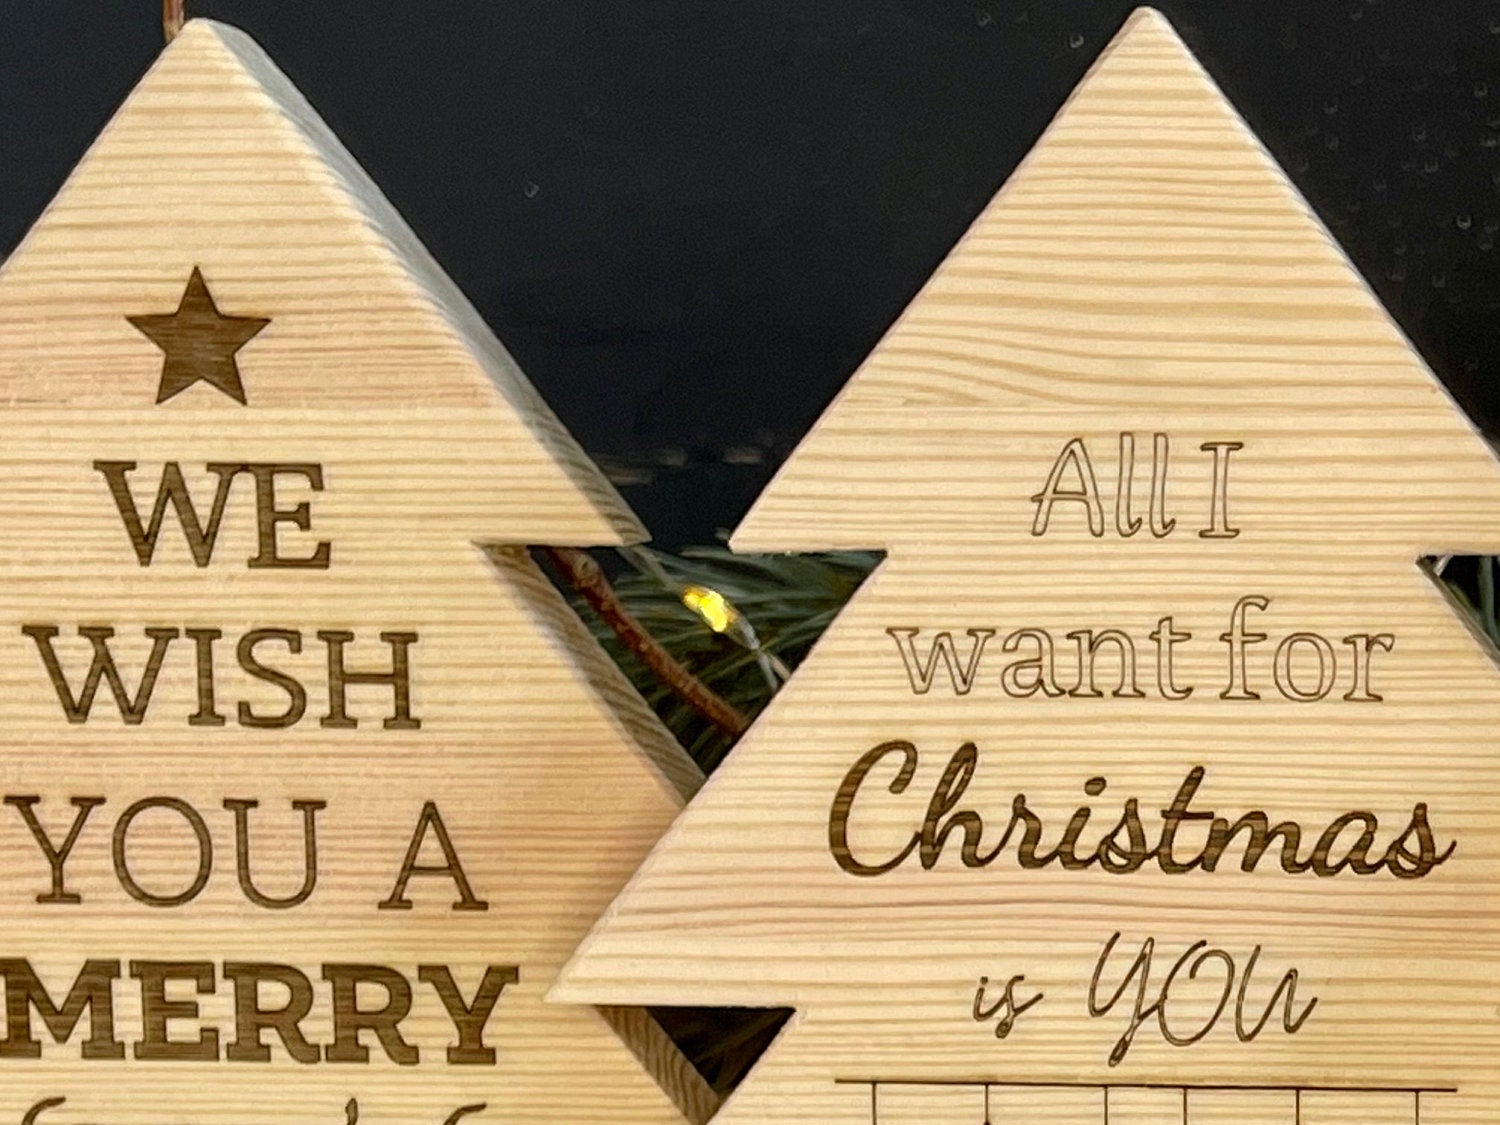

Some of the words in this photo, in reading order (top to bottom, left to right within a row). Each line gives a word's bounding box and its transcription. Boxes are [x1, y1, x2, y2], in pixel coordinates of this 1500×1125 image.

[91, 459, 332, 571] WE
[1029, 430, 1177, 539] All
[1198, 441, 1245, 540] I
[20, 622, 423, 731] WISH
[885, 615, 1194, 701] want
[1218, 594, 1396, 703] for
[2, 793, 328, 910] YOU
[377, 799, 490, 912] A
[828, 738, 1458, 880] Christmas
[0, 957, 521, 1067] MERRY
[972, 974, 1044, 1040] is
